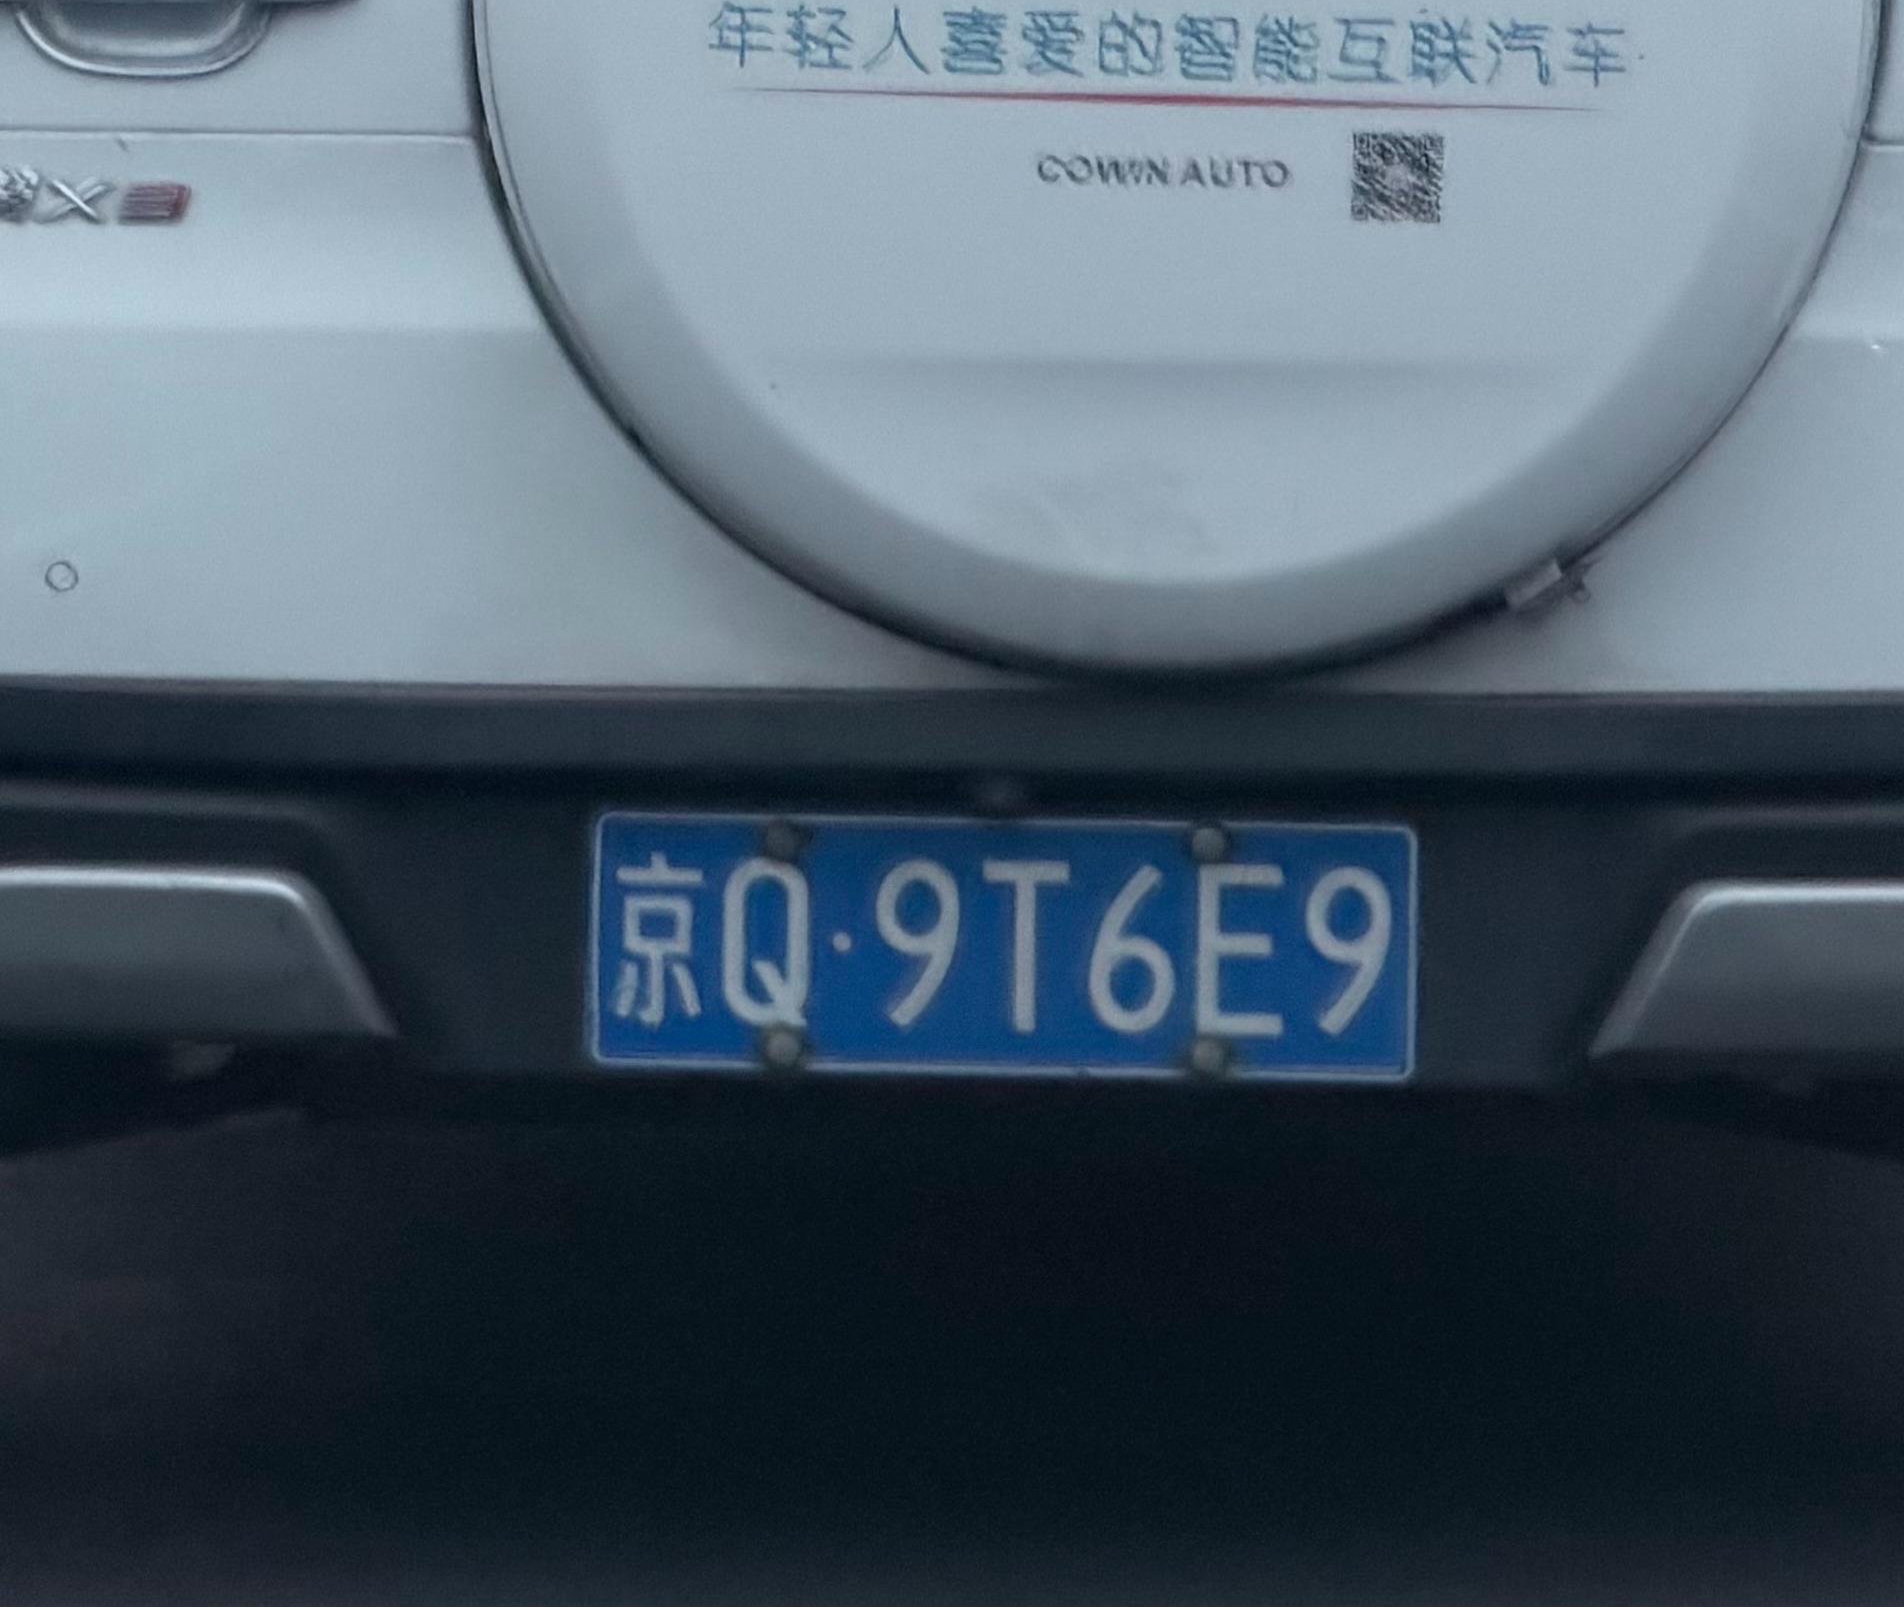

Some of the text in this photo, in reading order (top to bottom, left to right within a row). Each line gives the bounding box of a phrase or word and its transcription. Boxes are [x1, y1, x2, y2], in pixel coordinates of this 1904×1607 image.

[705, 0, 1628, 90] 年轻人喜爱的智能互联汽车
[1180, 156, 1292, 189] AUTO
